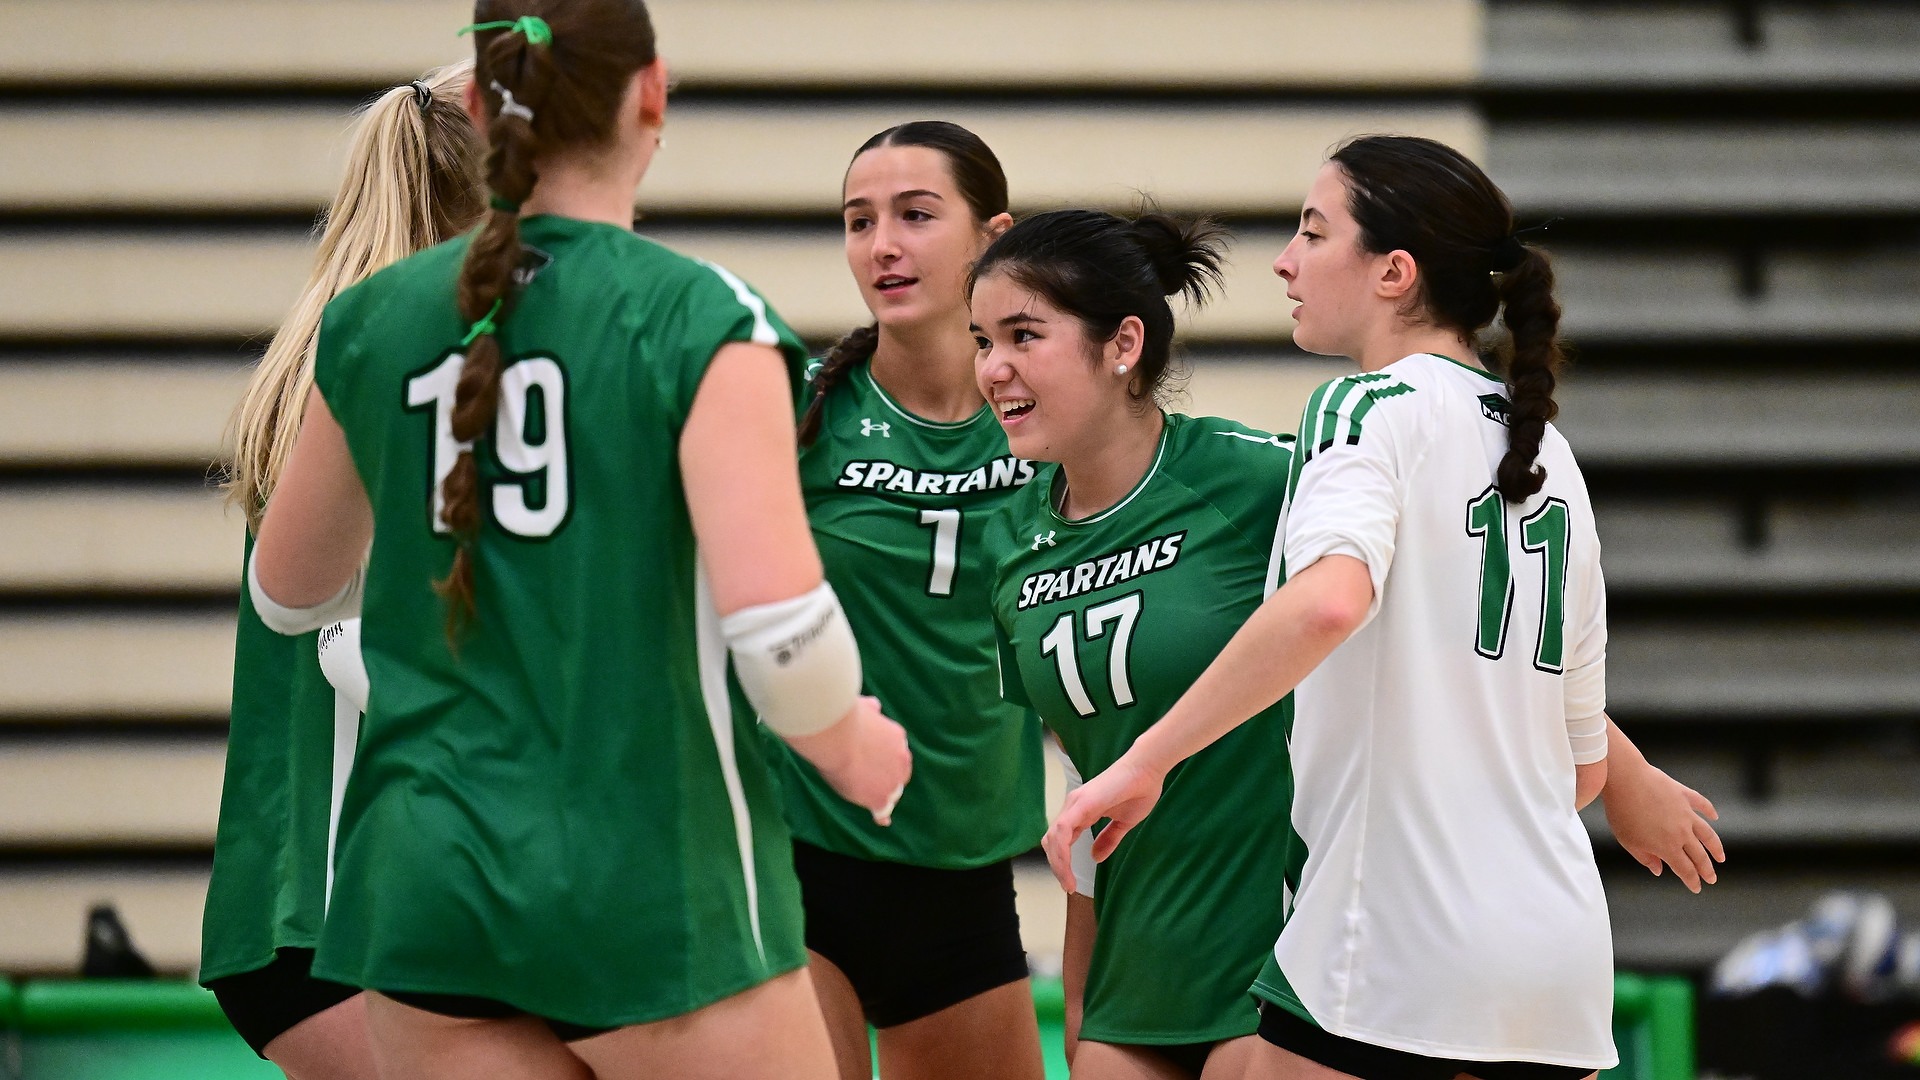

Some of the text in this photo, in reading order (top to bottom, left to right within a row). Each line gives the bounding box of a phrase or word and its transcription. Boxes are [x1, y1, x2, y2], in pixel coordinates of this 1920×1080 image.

[405, 350, 572, 539] 19
[838, 456, 1037, 495] SPARTANS
[918, 508, 963, 596] 1
[1018, 532, 1188, 612] SPARTANS
[1466, 484, 1571, 675] 11
[1041, 592, 1142, 717] 17
